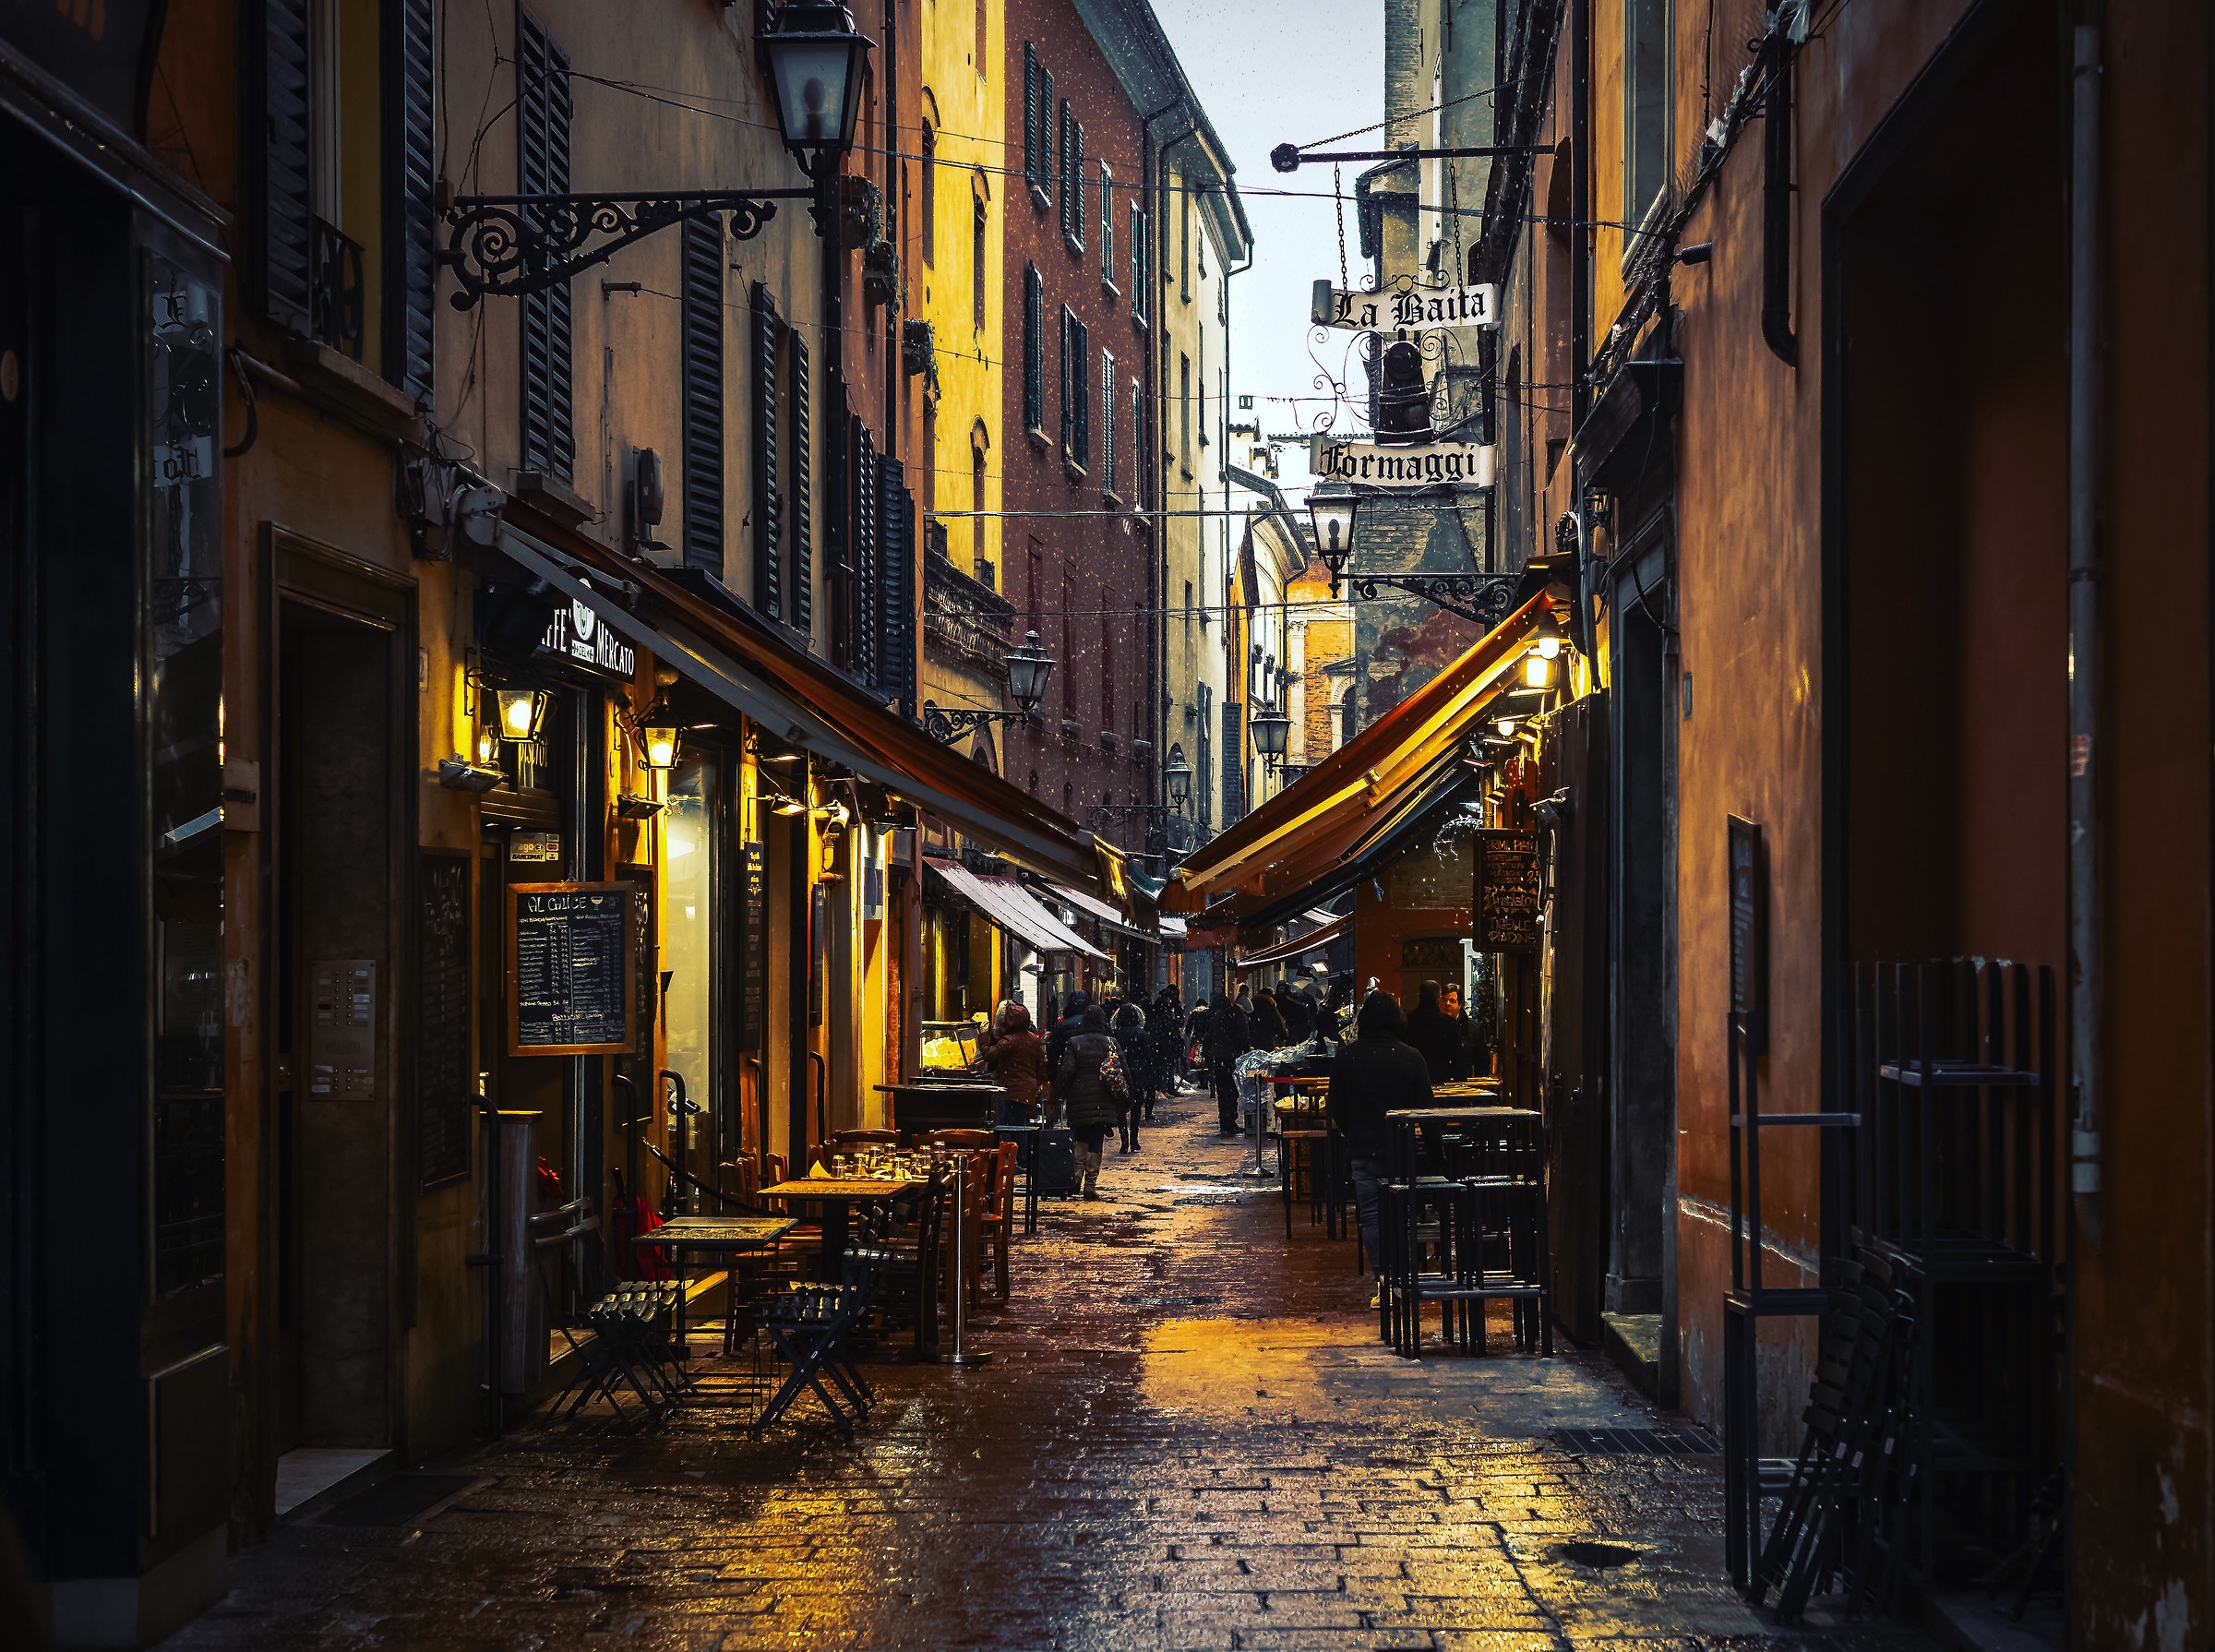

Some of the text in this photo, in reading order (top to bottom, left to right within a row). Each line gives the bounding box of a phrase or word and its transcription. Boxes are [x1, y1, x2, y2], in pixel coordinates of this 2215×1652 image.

[1333, 290, 1486, 331] La Baita
[1319, 442, 1477, 483] Formaggi
[596, 619, 635, 676] MERCATO
[528, 896, 545, 912] AL
[1488, 930, 1536, 943] PIADINE
